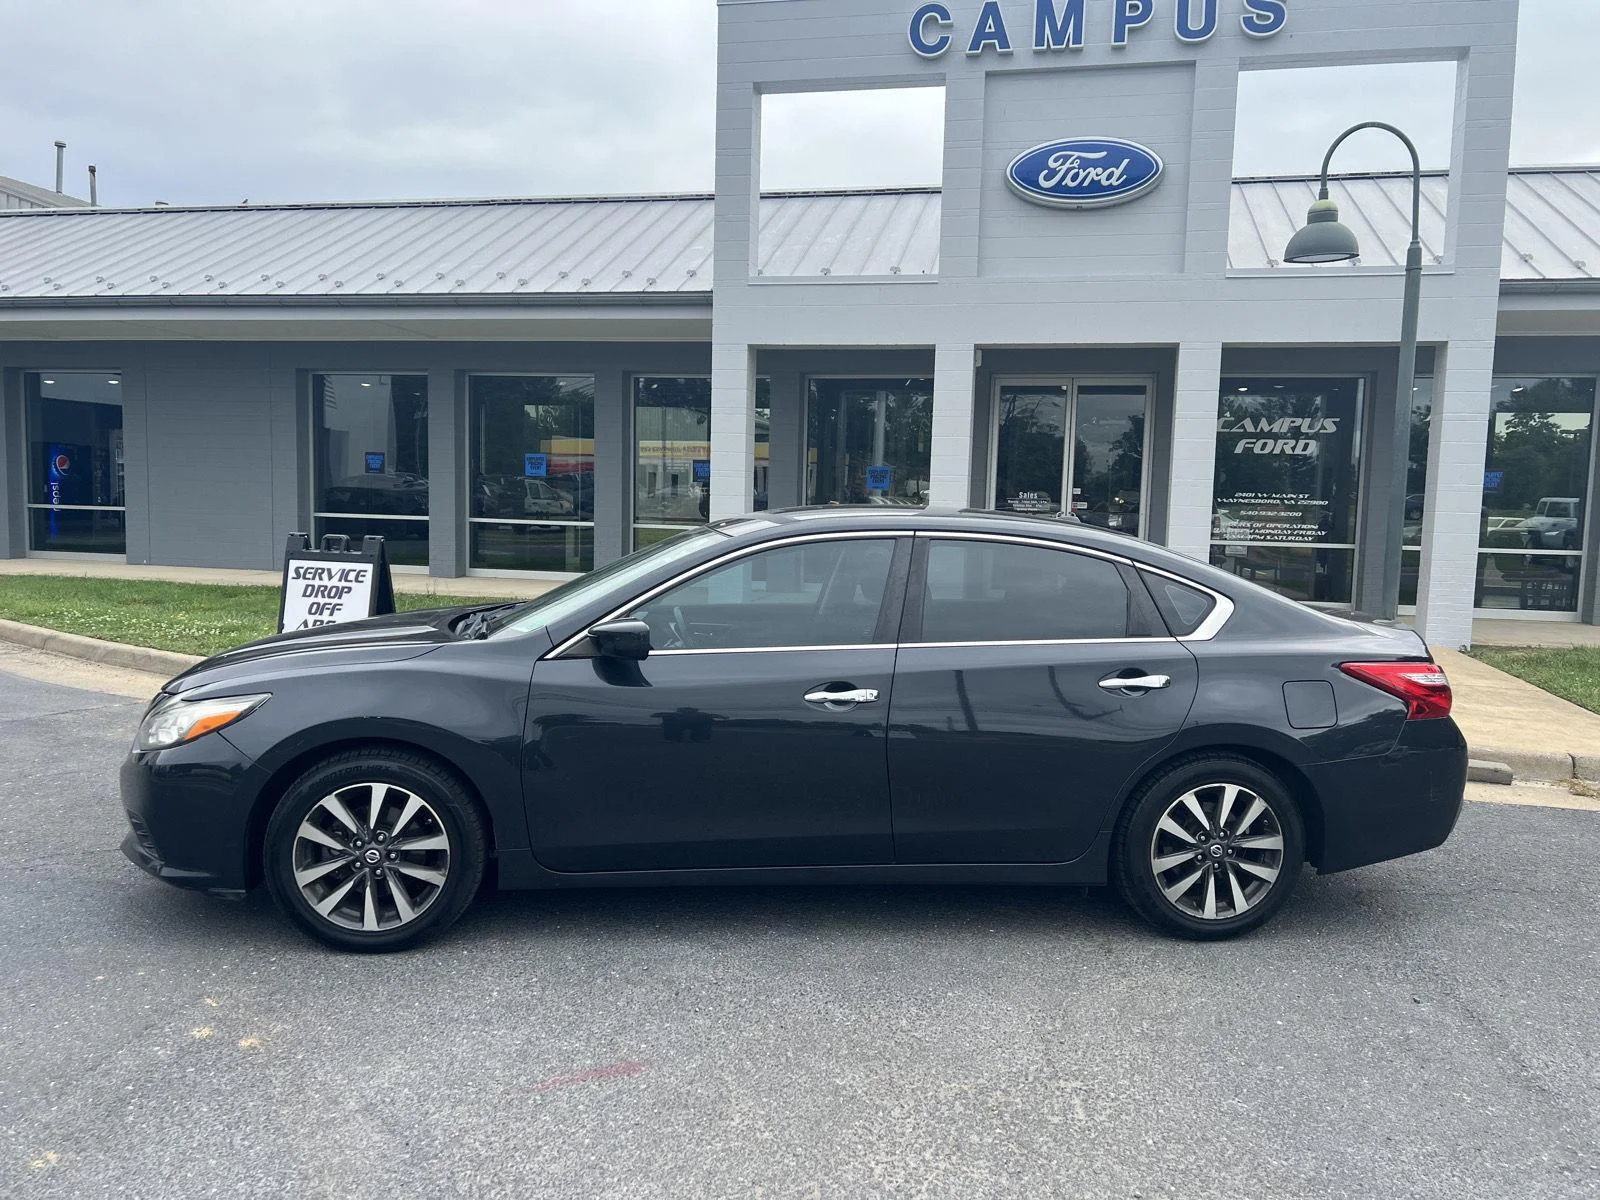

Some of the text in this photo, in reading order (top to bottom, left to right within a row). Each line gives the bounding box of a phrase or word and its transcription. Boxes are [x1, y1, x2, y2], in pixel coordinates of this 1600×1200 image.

[908, 0, 1289, 59] CAMPUS
[1038, 150, 1128, 188] Ford
[1216, 416, 1340, 433] CAMPUS
[1234, 438, 1317, 454] FORD
[1019, 491, 1038, 499] Sales
[291, 566, 368, 583] SERVICE
[302, 584, 352, 599] DROP
[307, 602, 343, 616] OFF
